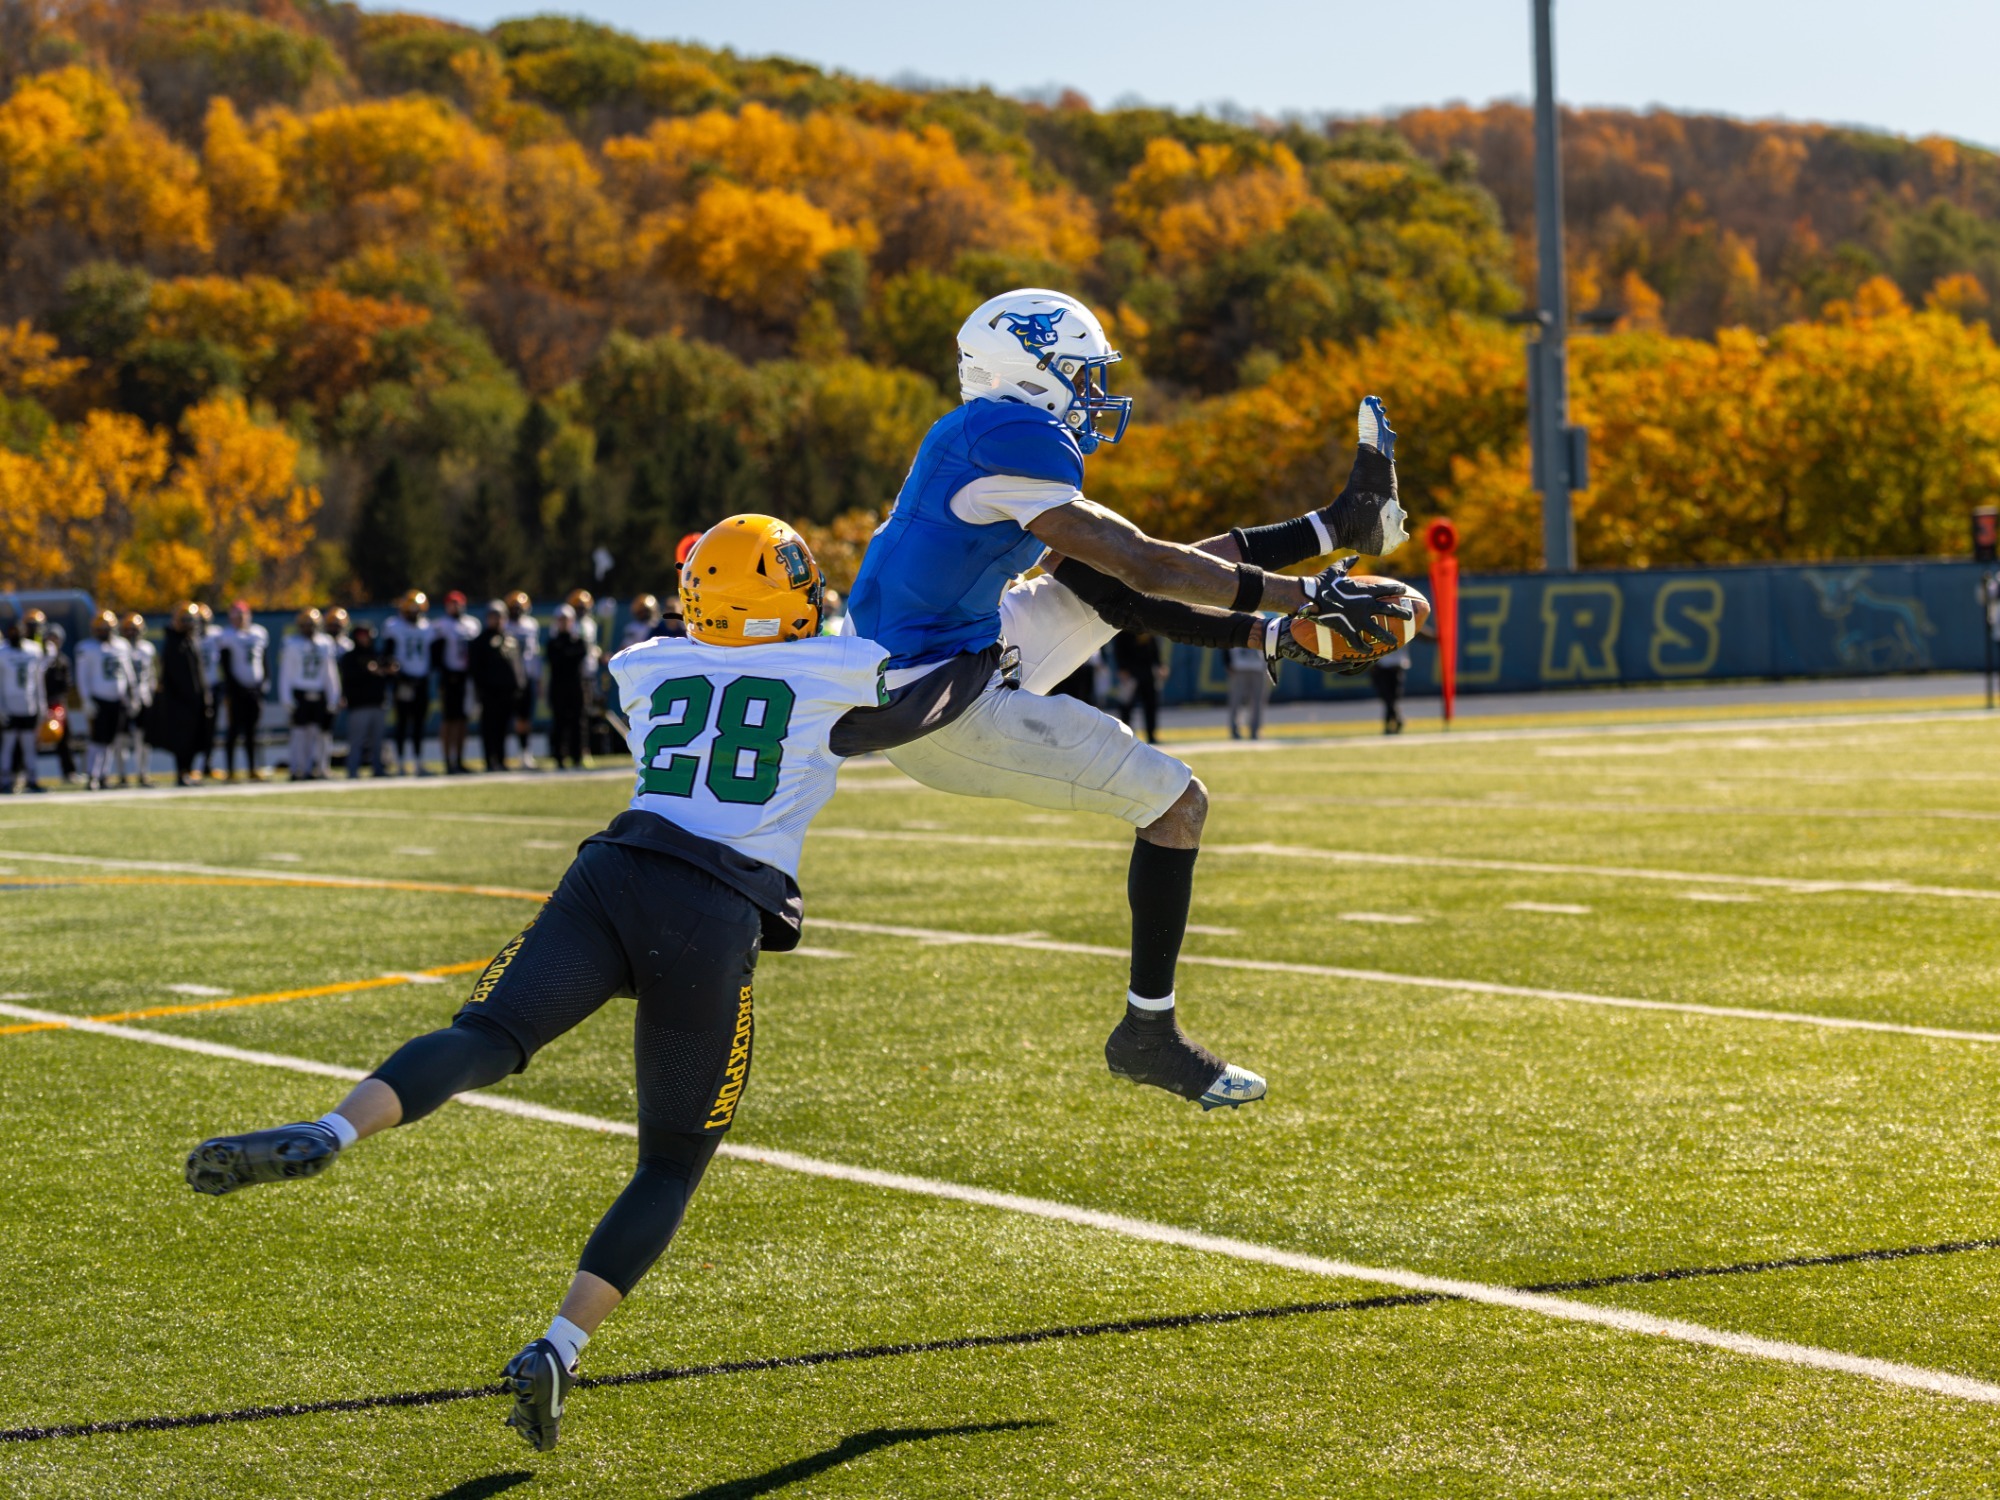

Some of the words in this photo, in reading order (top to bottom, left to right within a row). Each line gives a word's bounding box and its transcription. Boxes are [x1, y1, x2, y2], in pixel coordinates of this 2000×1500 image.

[715, 619, 729, 629] 28
[1323, 579, 1724, 688] ERS
[638, 674, 796, 805] 28
[704, 983, 753, 1129] BROCKPORT
